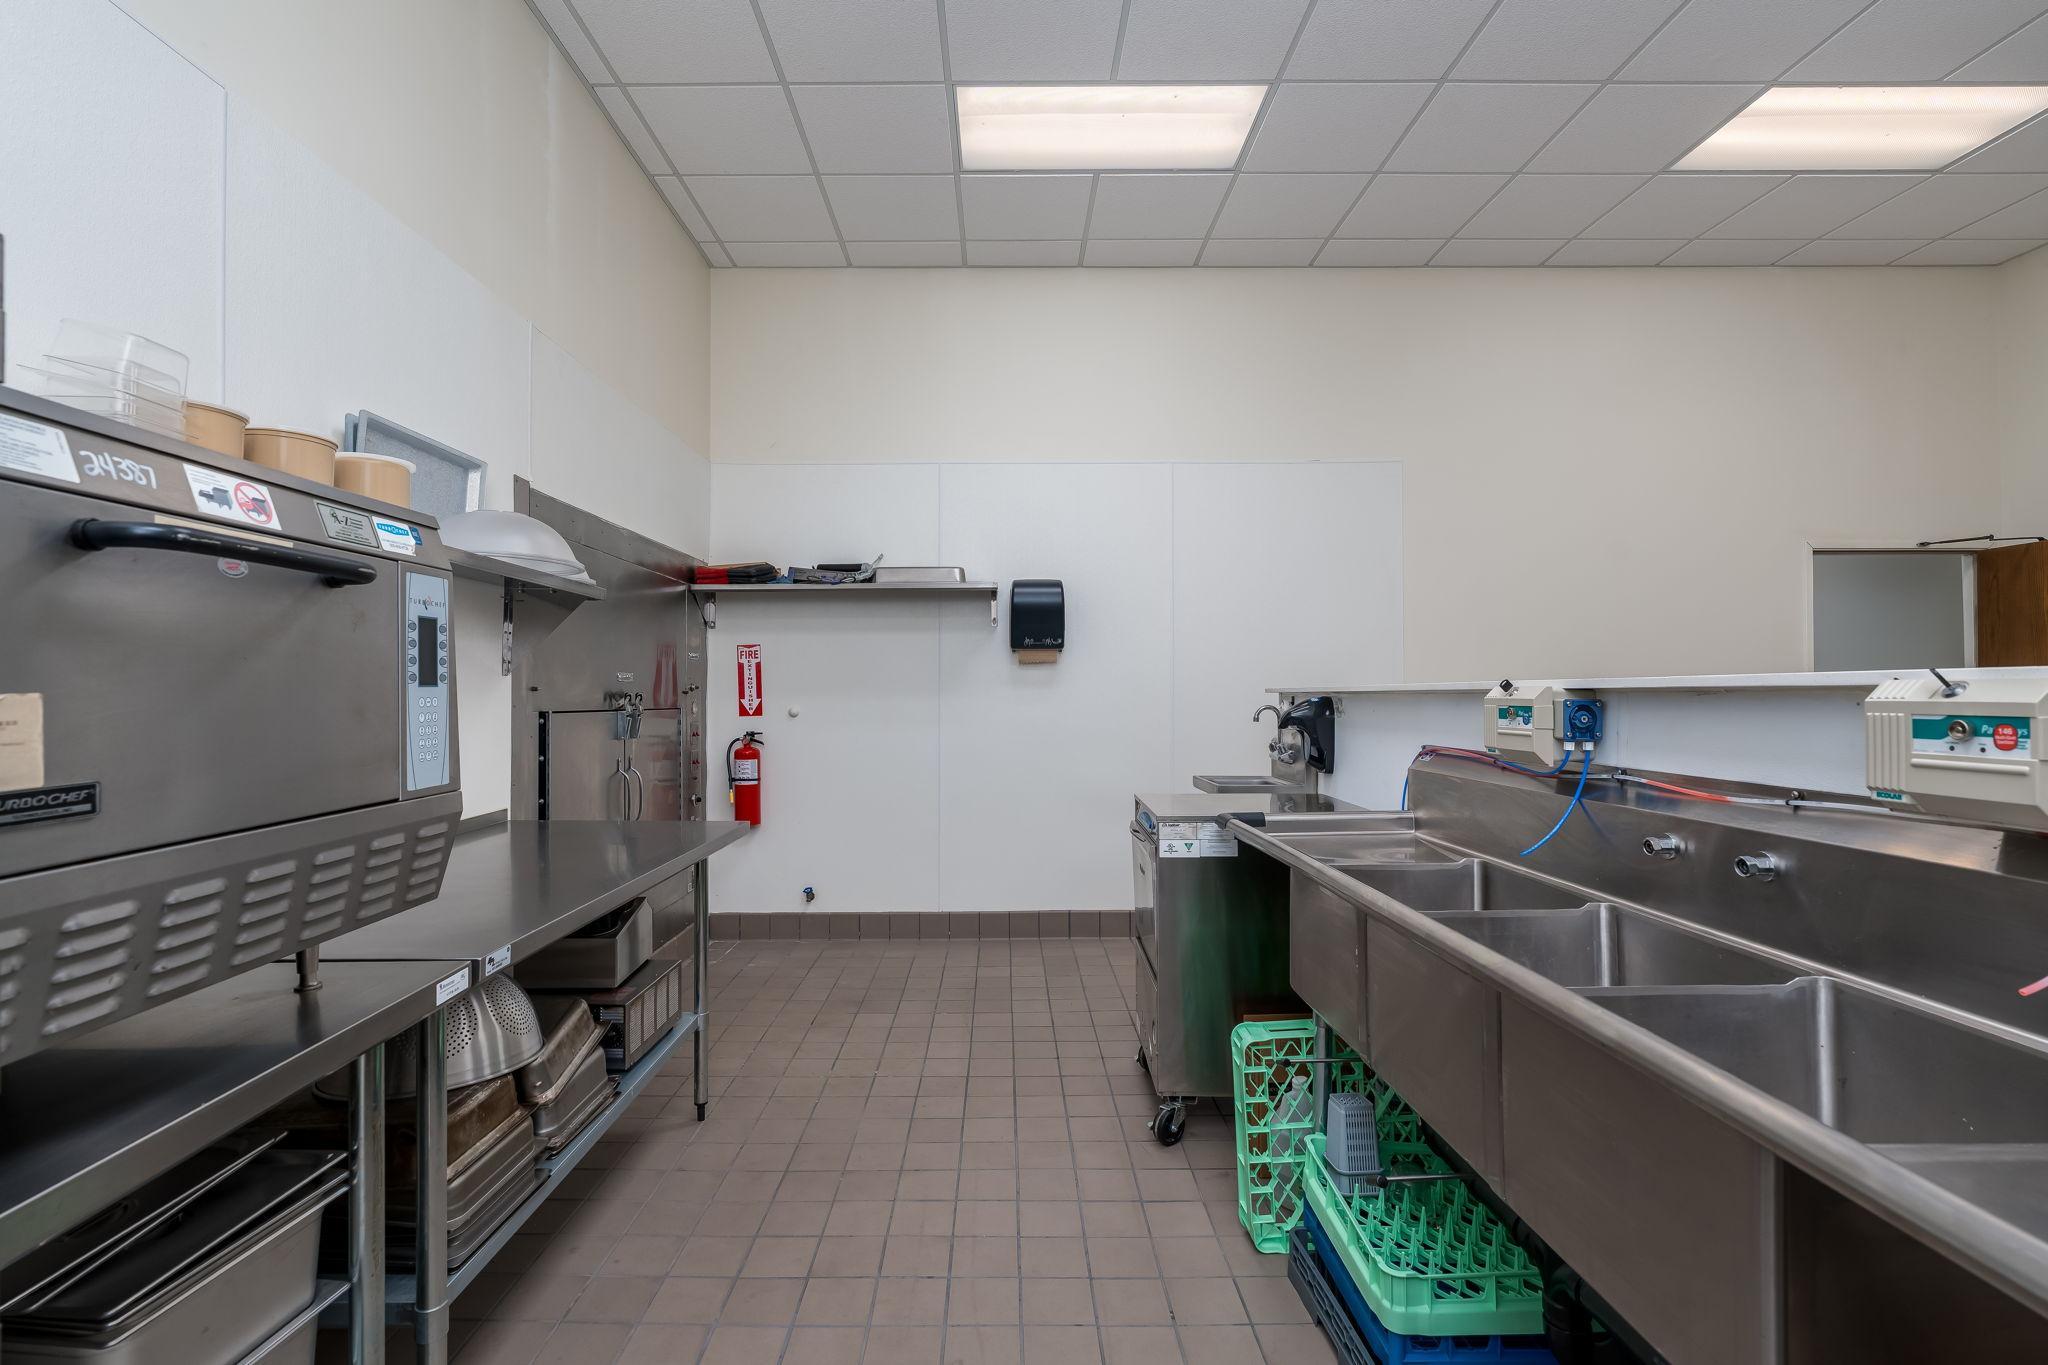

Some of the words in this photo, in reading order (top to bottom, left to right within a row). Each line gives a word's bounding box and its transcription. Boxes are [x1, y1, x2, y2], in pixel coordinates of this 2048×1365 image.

[79, 450, 157, 489] 24387
[739, 650, 759, 660] FIRE
[1876, 791, 1903, 801] ECOLAB
